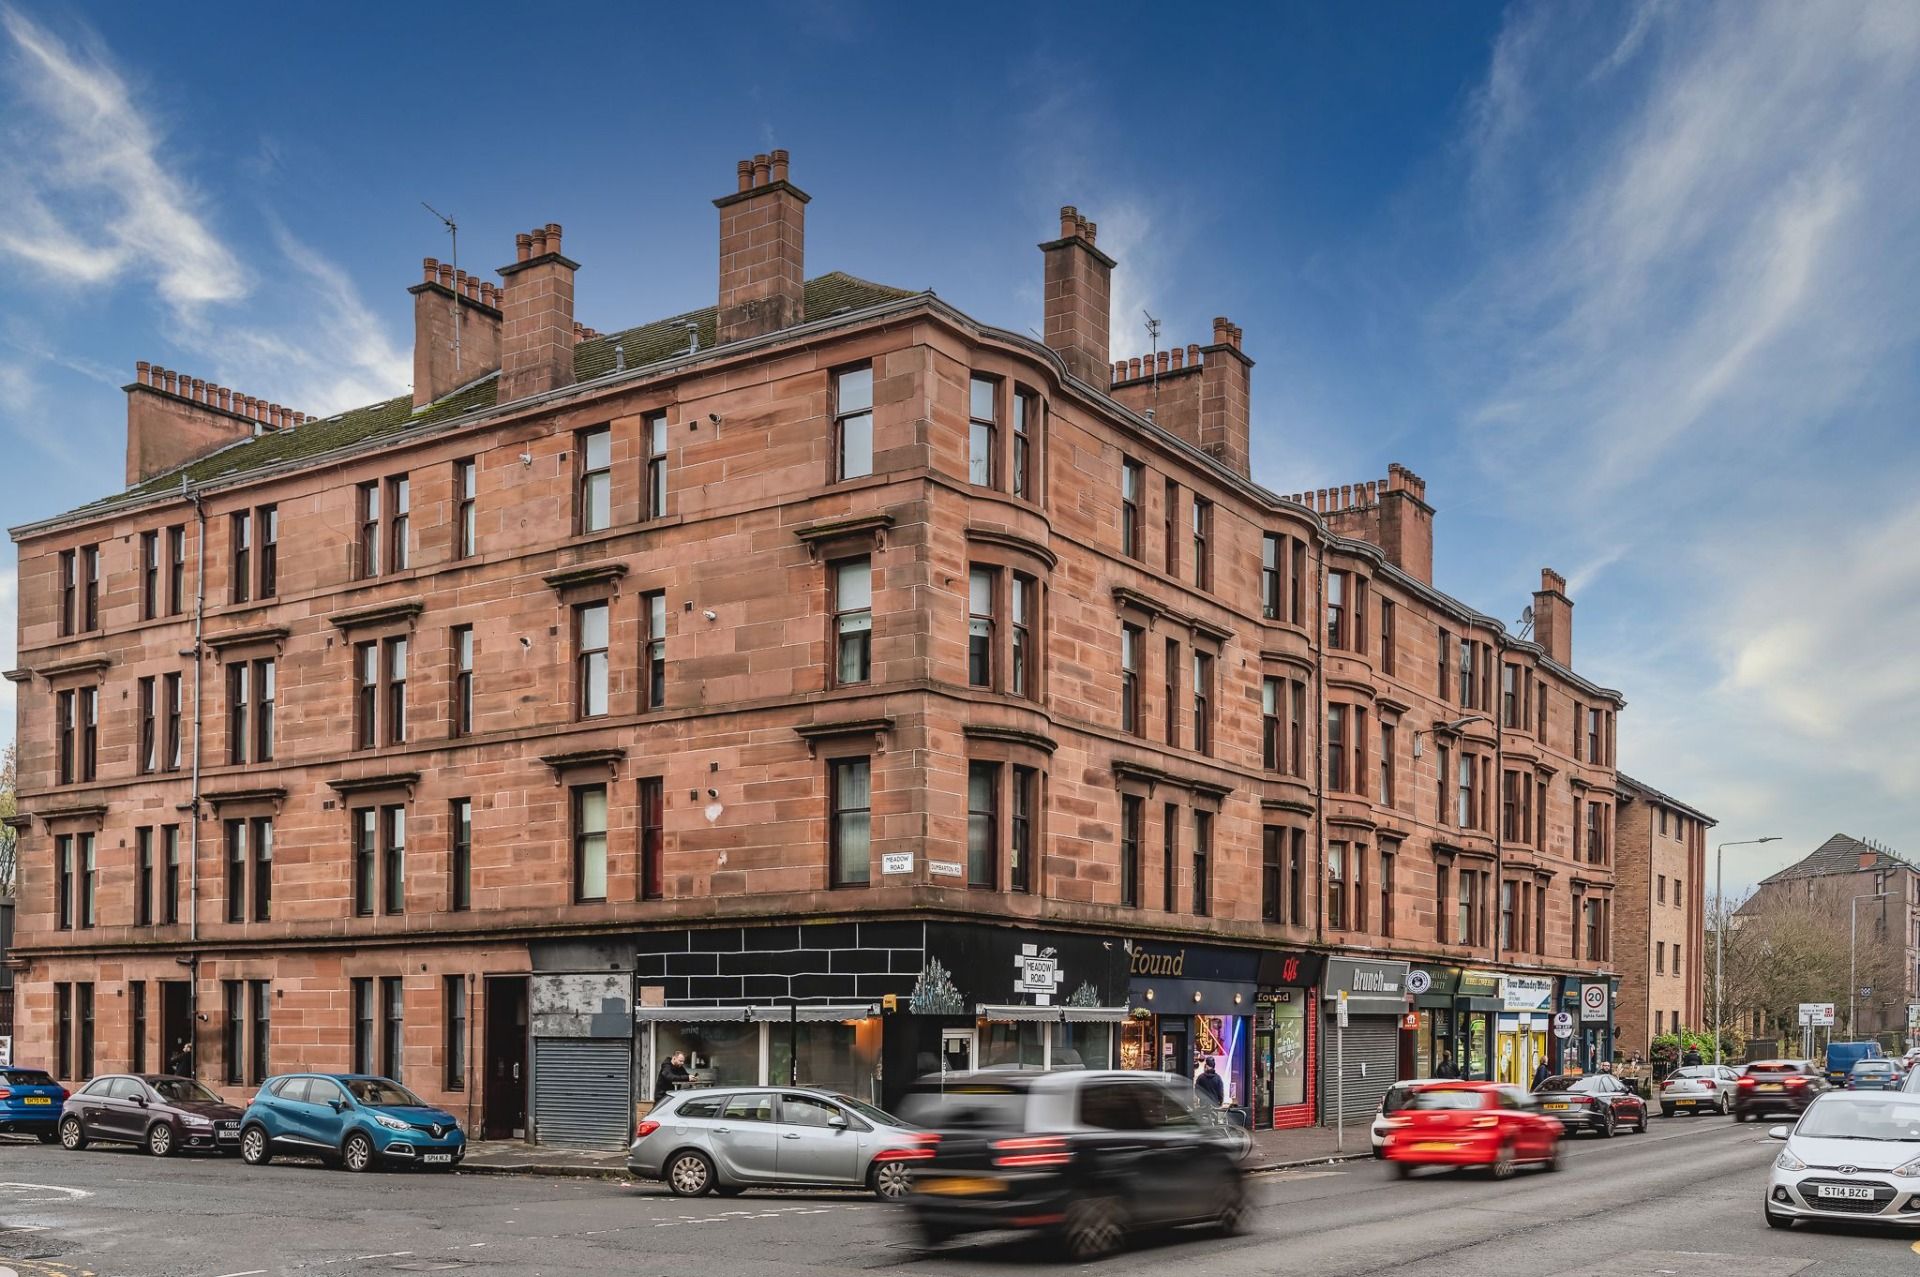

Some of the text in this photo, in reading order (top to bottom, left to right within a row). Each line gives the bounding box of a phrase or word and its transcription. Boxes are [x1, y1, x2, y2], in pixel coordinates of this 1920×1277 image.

[885, 855, 910, 863] MEADOW
[889, 863, 905, 871] ROAD
[1130, 946, 1185, 976] found
[1026, 962, 1052, 973] MEADOW
[1030, 973, 1046, 984] ROAD
[1352, 967, 1385, 992] Brunch
[1257, 992, 1290, 1002] found
[1588, 992, 1601, 1002] 20
[1824, 1186, 1868, 1198] ST14 BZG
